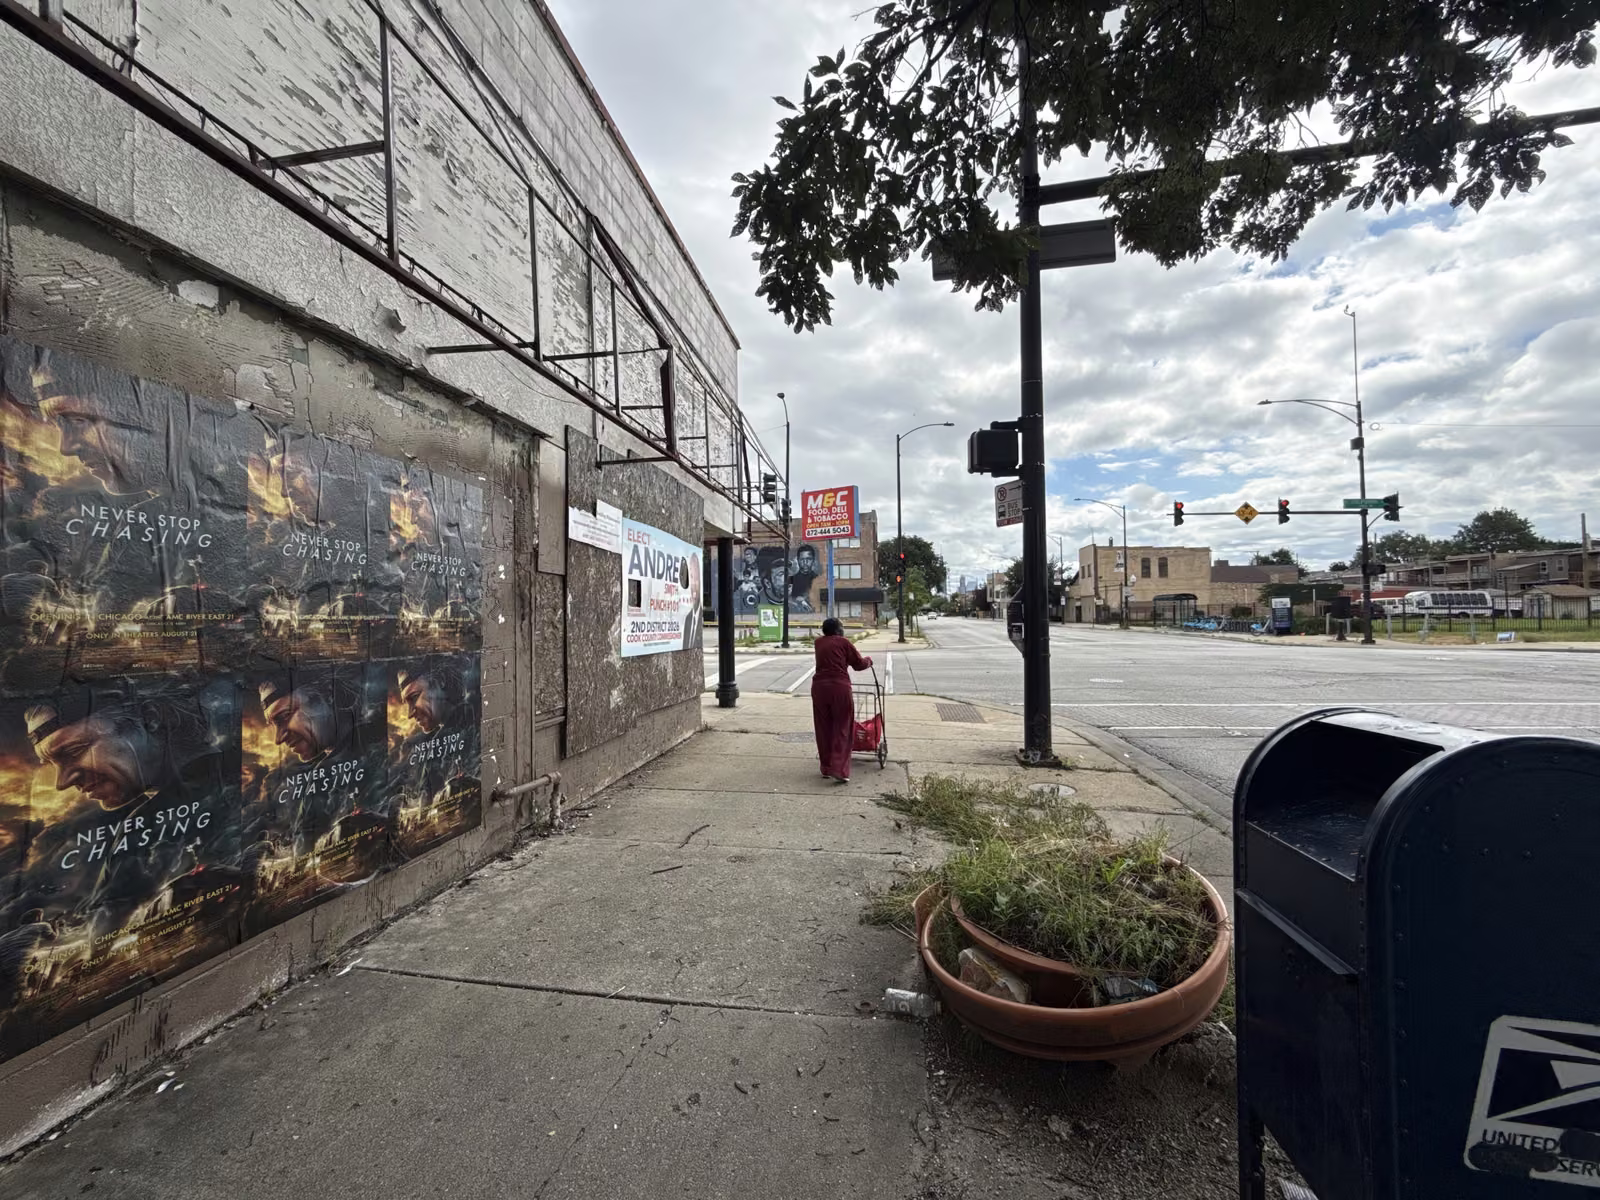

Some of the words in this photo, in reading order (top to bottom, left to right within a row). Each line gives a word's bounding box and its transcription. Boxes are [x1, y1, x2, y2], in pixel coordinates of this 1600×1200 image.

[807, 490, 849, 509] M&C
[1008, 501, 1018, 510] BUS
[81, 504, 147, 525] NEVER
[158, 514, 201, 530] STOP
[808, 508, 830, 516] FOOD,
[813, 513, 849, 522] TOBACCO
[1008, 508, 1021, 517] STOP
[66, 518, 212, 547] CHASING
[628, 528, 651, 545] ELECT
[832, 526, 850, 534] 5043
[291, 533, 329, 547] NEVER
[334, 539, 361, 551] STOP
[283, 544, 367, 564] CHASING
[417, 552, 442, 563] NEVER
[444, 556, 462, 566] STOP
[411, 561, 466, 576] CHASING
[628, 544, 680, 583] ANDRE
[650, 598, 667, 611] PUNCH
[30, 613, 81, 621] OPENING
[98, 613, 142, 621] CHICAGO
[123, 631, 158, 639] THEATERS
[631, 621, 646, 633] 2ND
[647, 621, 667, 632] DISTRICT
[627, 634, 642, 643] COOK
[415, 738, 440, 753] NEVER
[443, 732, 460, 745] STOP
[410, 740, 465, 765] CHASING
[286, 768, 325, 787] NEVER
[331, 760, 358, 775] STOP
[278, 769, 364, 803] CHASING
[77, 816, 144, 846] NEVER
[155, 802, 200, 824] STOP
[61, 812, 211, 869] CHASING
[24, 947, 77, 974] OPENING
[94, 924, 140, 945] CHICAGO
[163, 904, 182, 917] AMC
[183, 895, 205, 908] RIVER
[206, 887, 224, 899] EAST
[225, 883, 233, 892] 21
[81, 955, 105, 970] ONLY
[107, 951, 117, 960] IN
[120, 934, 157, 952] THEATERS
[158, 920, 187, 937] AUGUST
[187, 916, 195, 925] 21
[1482, 1129, 1560, 1152] UNITED
